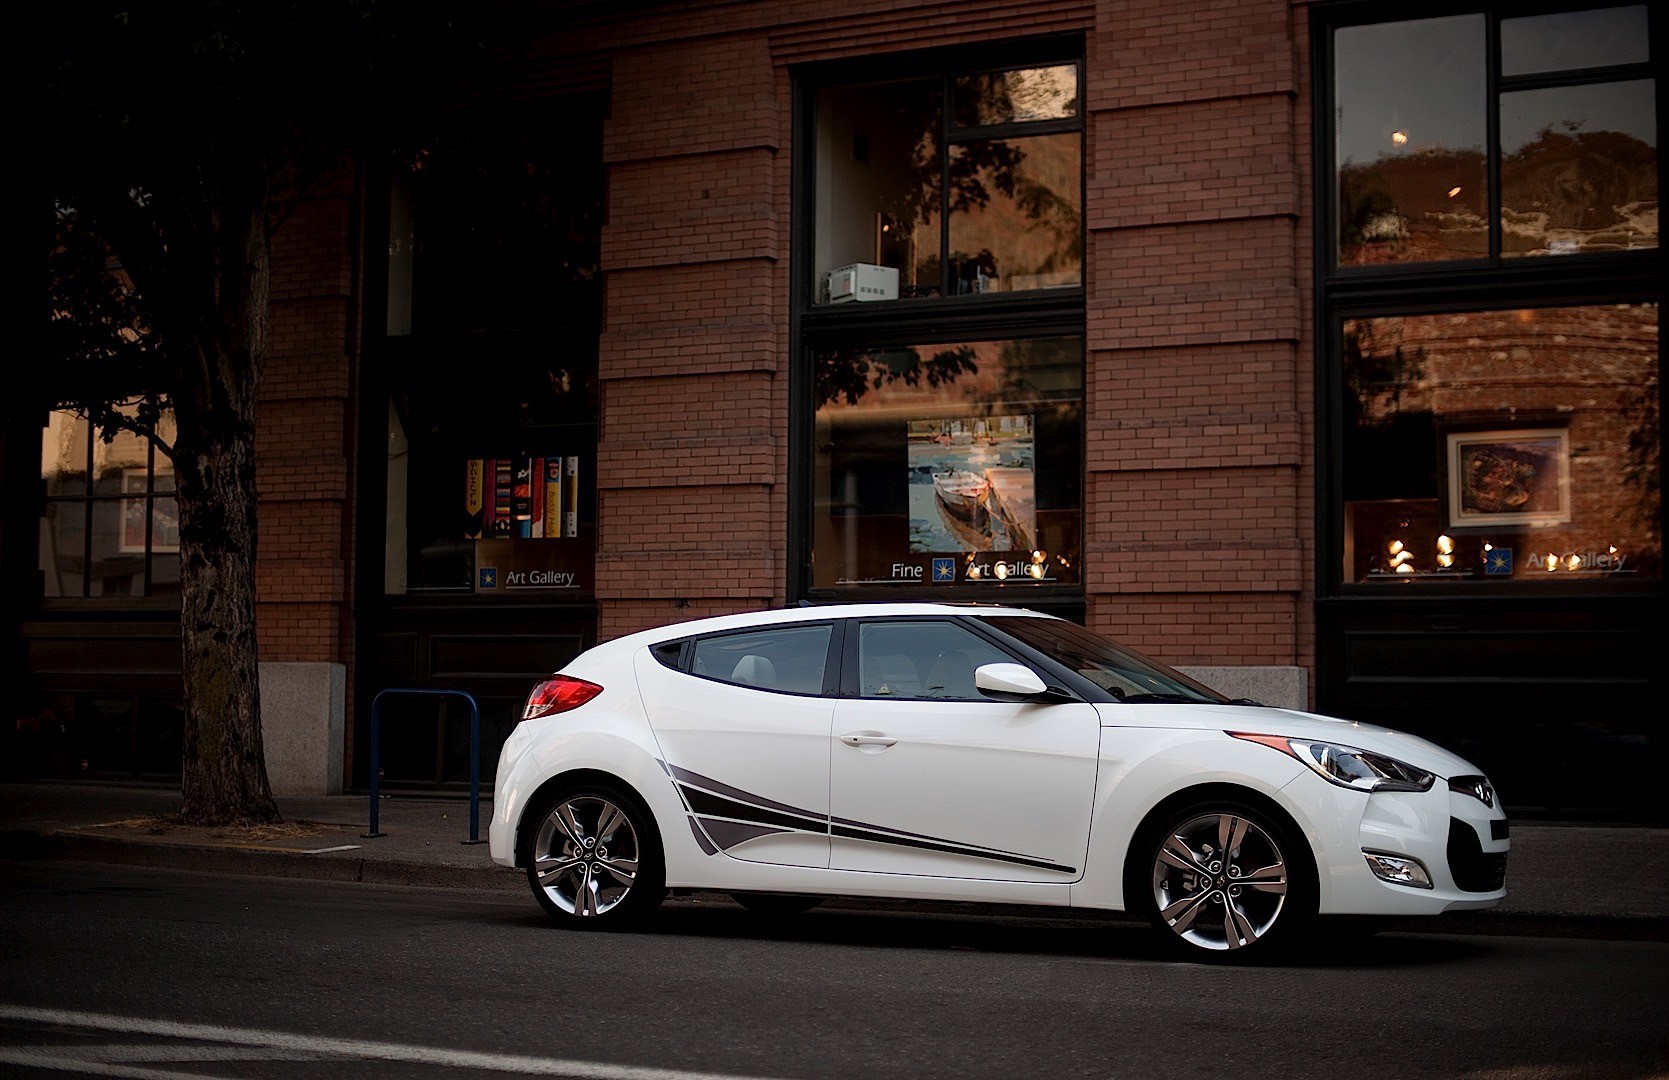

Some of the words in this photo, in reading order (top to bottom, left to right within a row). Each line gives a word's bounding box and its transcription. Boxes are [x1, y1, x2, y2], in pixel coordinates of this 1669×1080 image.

[891, 563, 924, 578] Fine
[965, 561, 991, 577] Art
[993, 560, 1050, 579] Galley
[1525, 553, 1556, 569] Ar
[1562, 551, 1629, 572] Gallery
[505, 571, 526, 584] Art
[529, 570, 575, 587] Gallery
